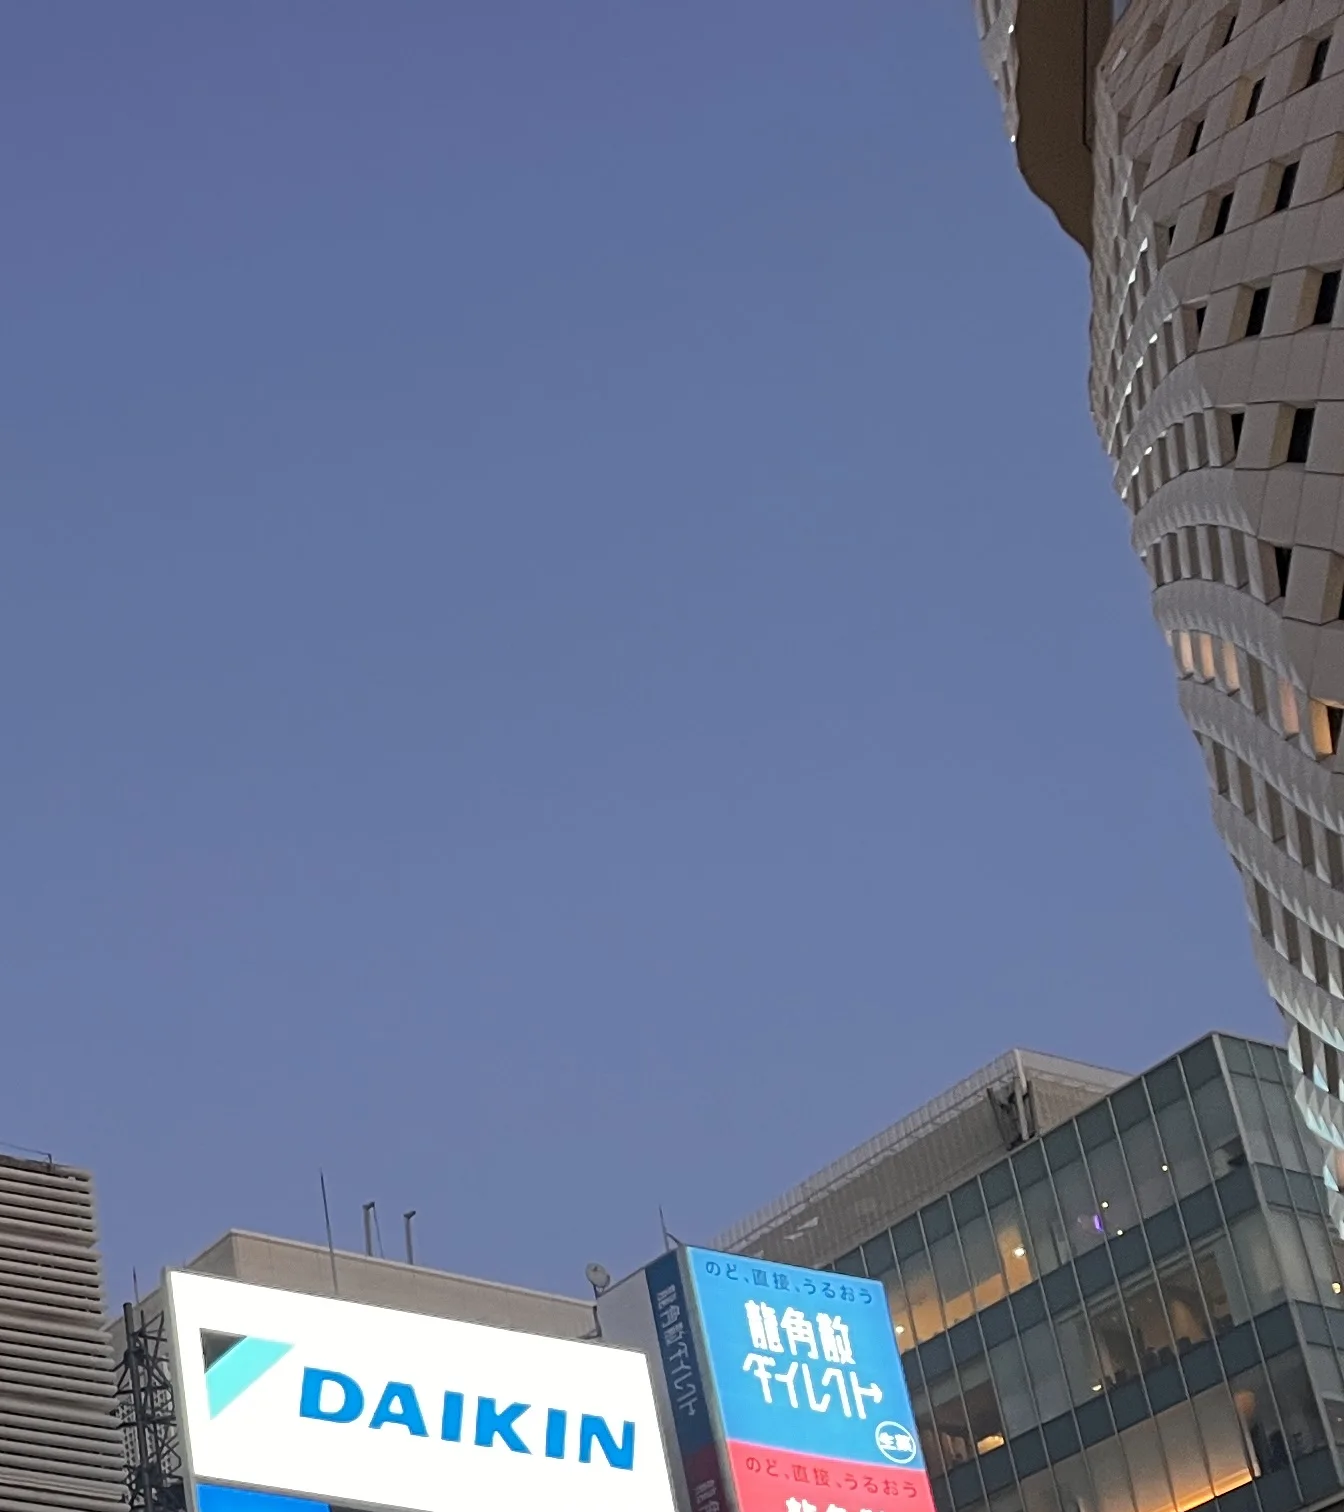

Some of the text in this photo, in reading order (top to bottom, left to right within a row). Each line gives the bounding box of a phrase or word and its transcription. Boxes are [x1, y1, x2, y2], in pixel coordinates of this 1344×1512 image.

[705, 1260, 873, 1304] のど、直接、うるおう
[744, 1299, 856, 1365] 龍角散
[299, 1366, 635, 1471] DAIKIN
